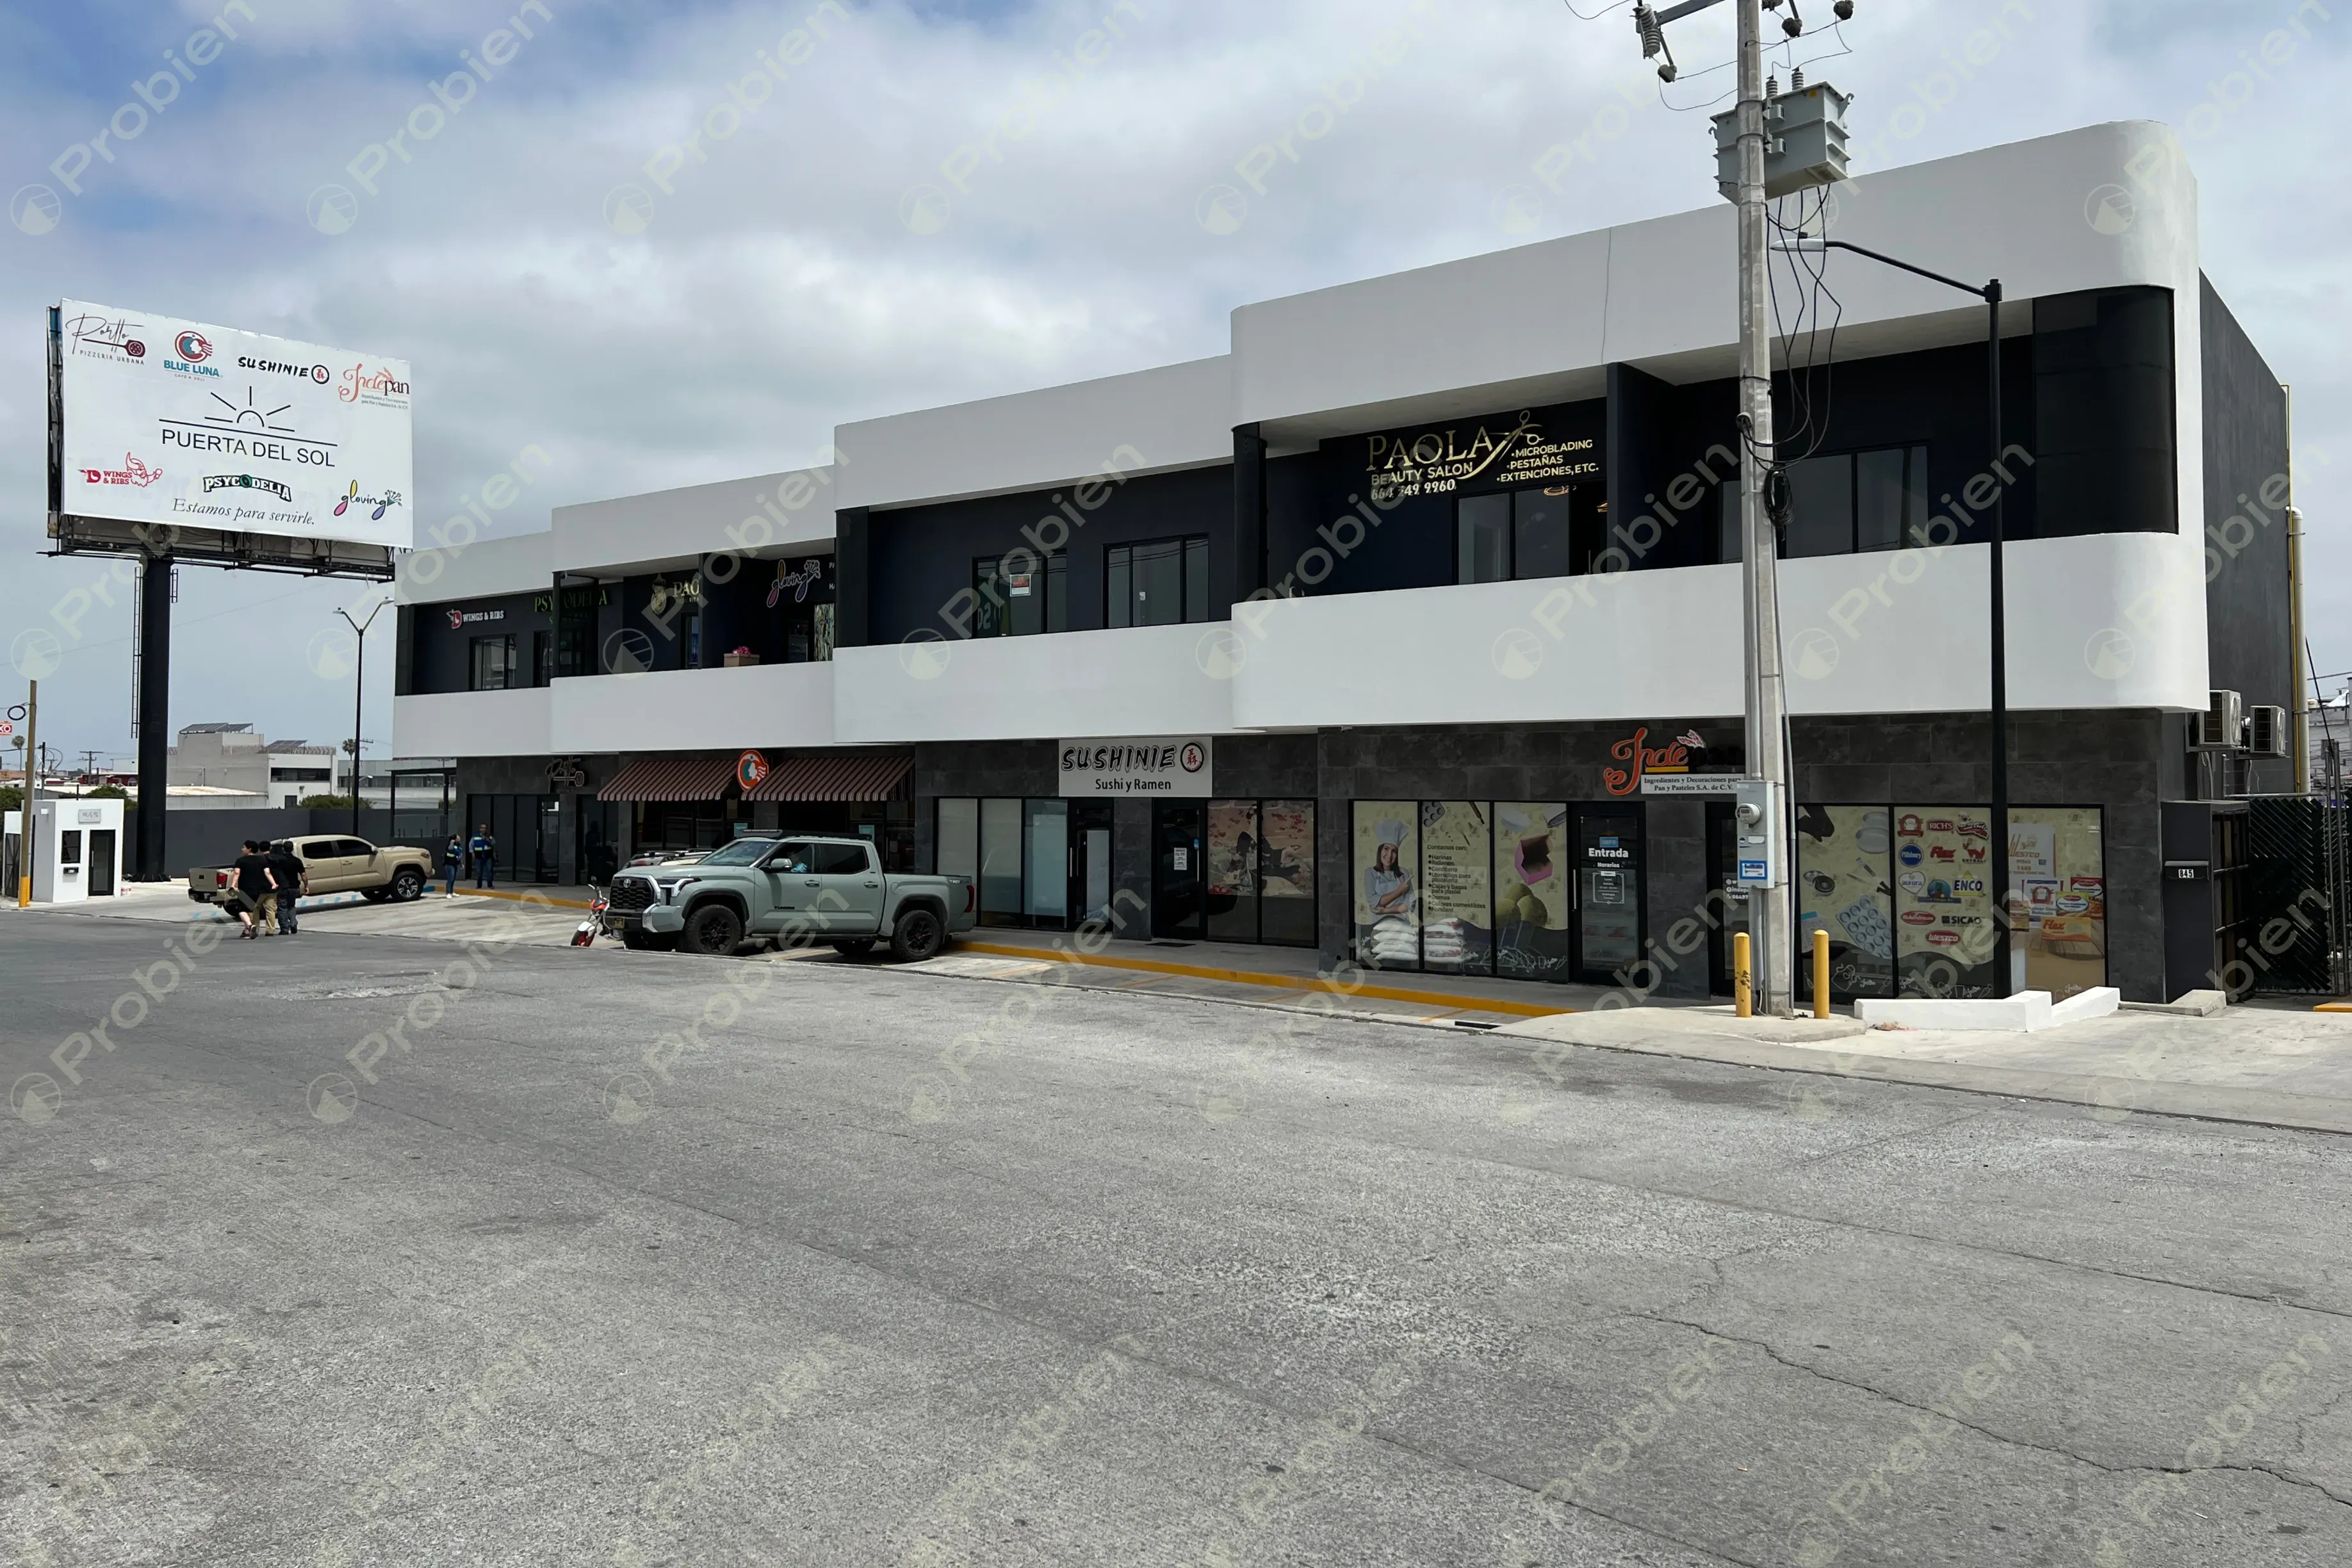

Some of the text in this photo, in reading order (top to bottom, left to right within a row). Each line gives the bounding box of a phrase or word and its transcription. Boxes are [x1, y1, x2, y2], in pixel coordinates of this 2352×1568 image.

[80, 350, 144, 365] PIZZERIA URBANA
[238, 356, 309, 377] SUSHINIE
[164, 359, 220, 377] BLUE LUNA
[338, 363, 410, 402] Indepan
[162, 429, 335, 467] PUERTA DEL SOL
[1366, 426, 1493, 471] PAOLA
[1515, 439, 1593, 458] MICROBLADING
[1510, 454, 1564, 470] PESTAÑAS
[103, 470, 133, 478] WINGS
[1371, 461, 1473, 486] BEAUTY SALON
[203, 474, 292, 502] PSYCODELIA
[334, 479, 387, 520] gloving
[173, 498, 314, 525] Estamos para servirle.
[462, 610, 504, 622] WINGS & RIBS
[1061, 744, 1178, 772] SUSHINIE
[1095, 778, 1172, 792] Sushi y Ramen
[1588, 847, 1629, 858] Entrada
[2179, 869, 2193, 878] 845
[1954, 880, 1983, 891] ENCO
